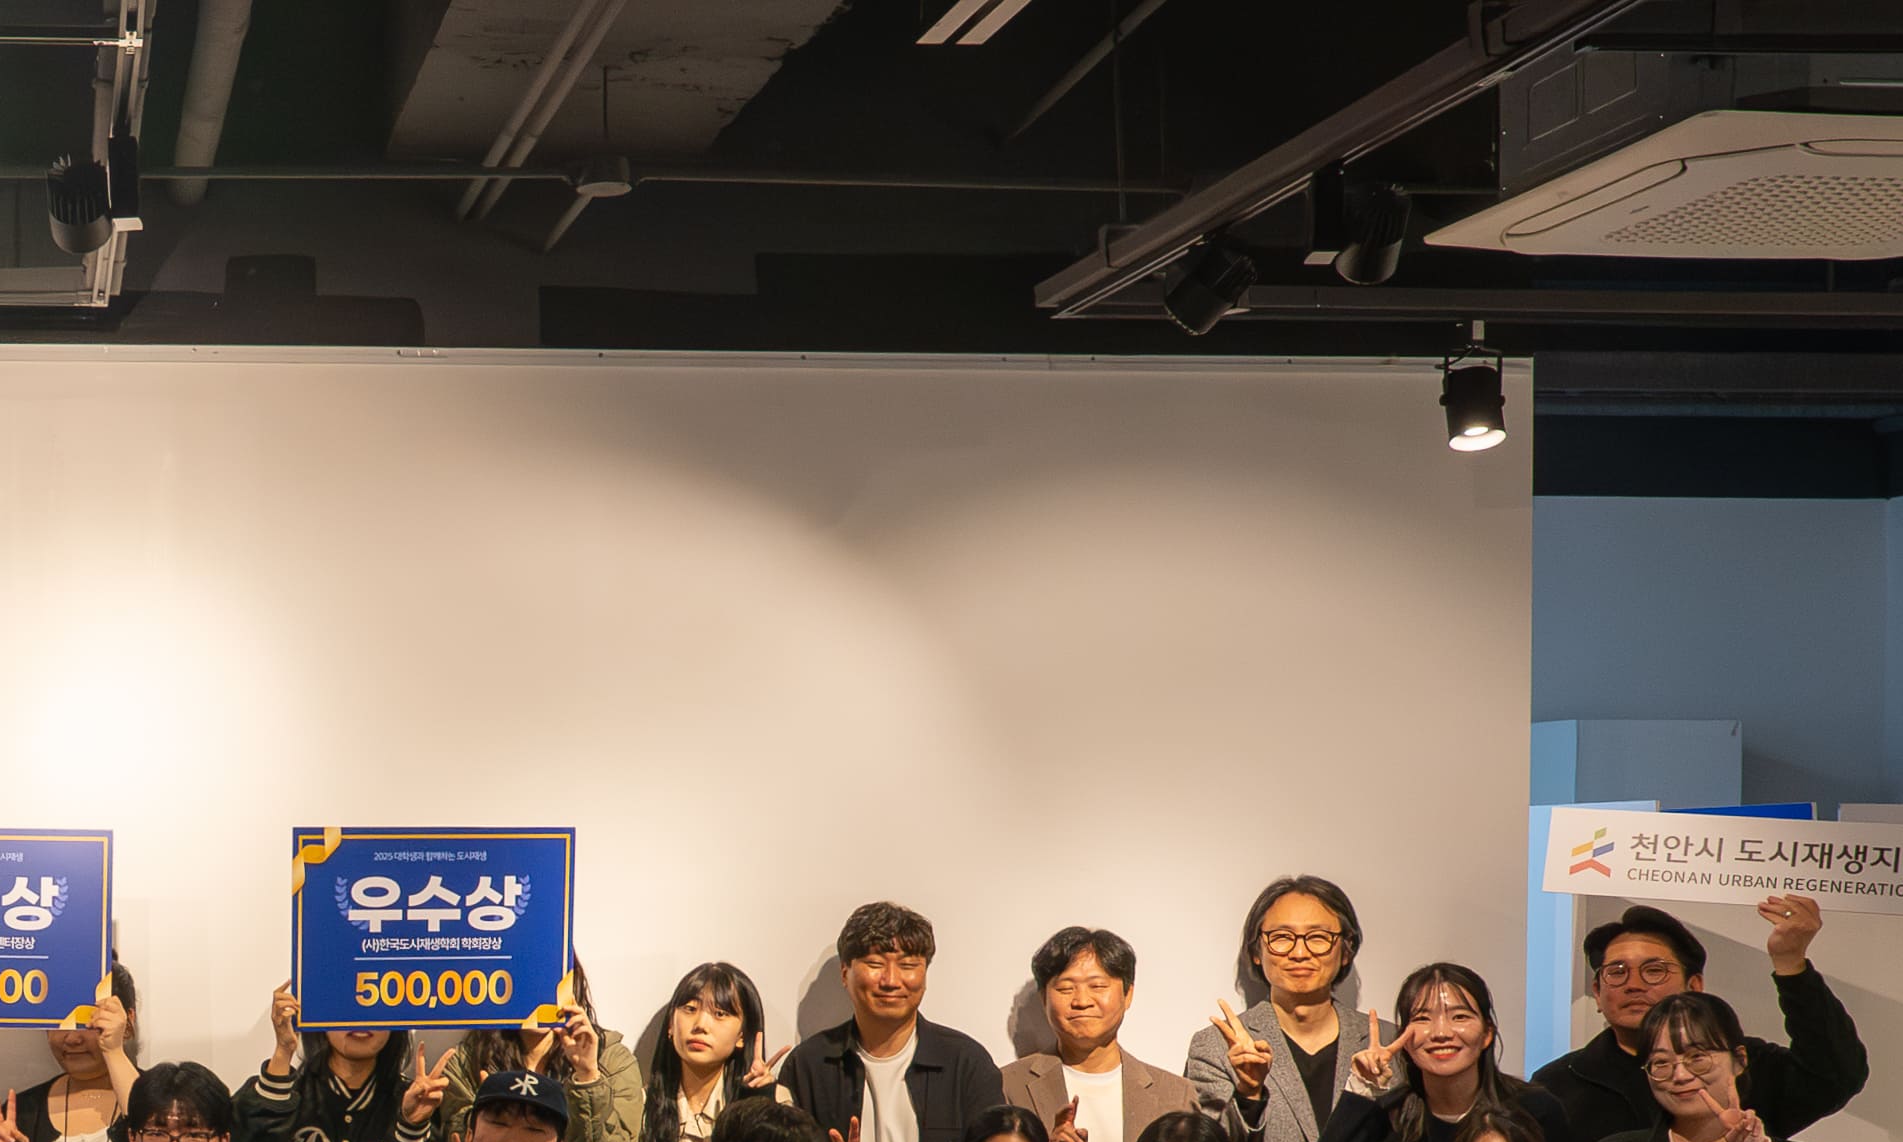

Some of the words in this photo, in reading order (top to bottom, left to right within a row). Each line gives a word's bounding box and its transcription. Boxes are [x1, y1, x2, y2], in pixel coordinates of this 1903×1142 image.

[1630, 833, 1723, 863] 천안시
[1734, 840, 1900, 875] 도시재생지
[1628, 868, 1712, 885] CHEONAN
[1719, 873, 1778, 889] URBAN
[348, 875, 522, 933] 우수상
[362, 938, 459, 952] (사)한국도시재생학회
[461, 937, 502, 950] 학회장상
[355, 970, 512, 1008] 500,000
